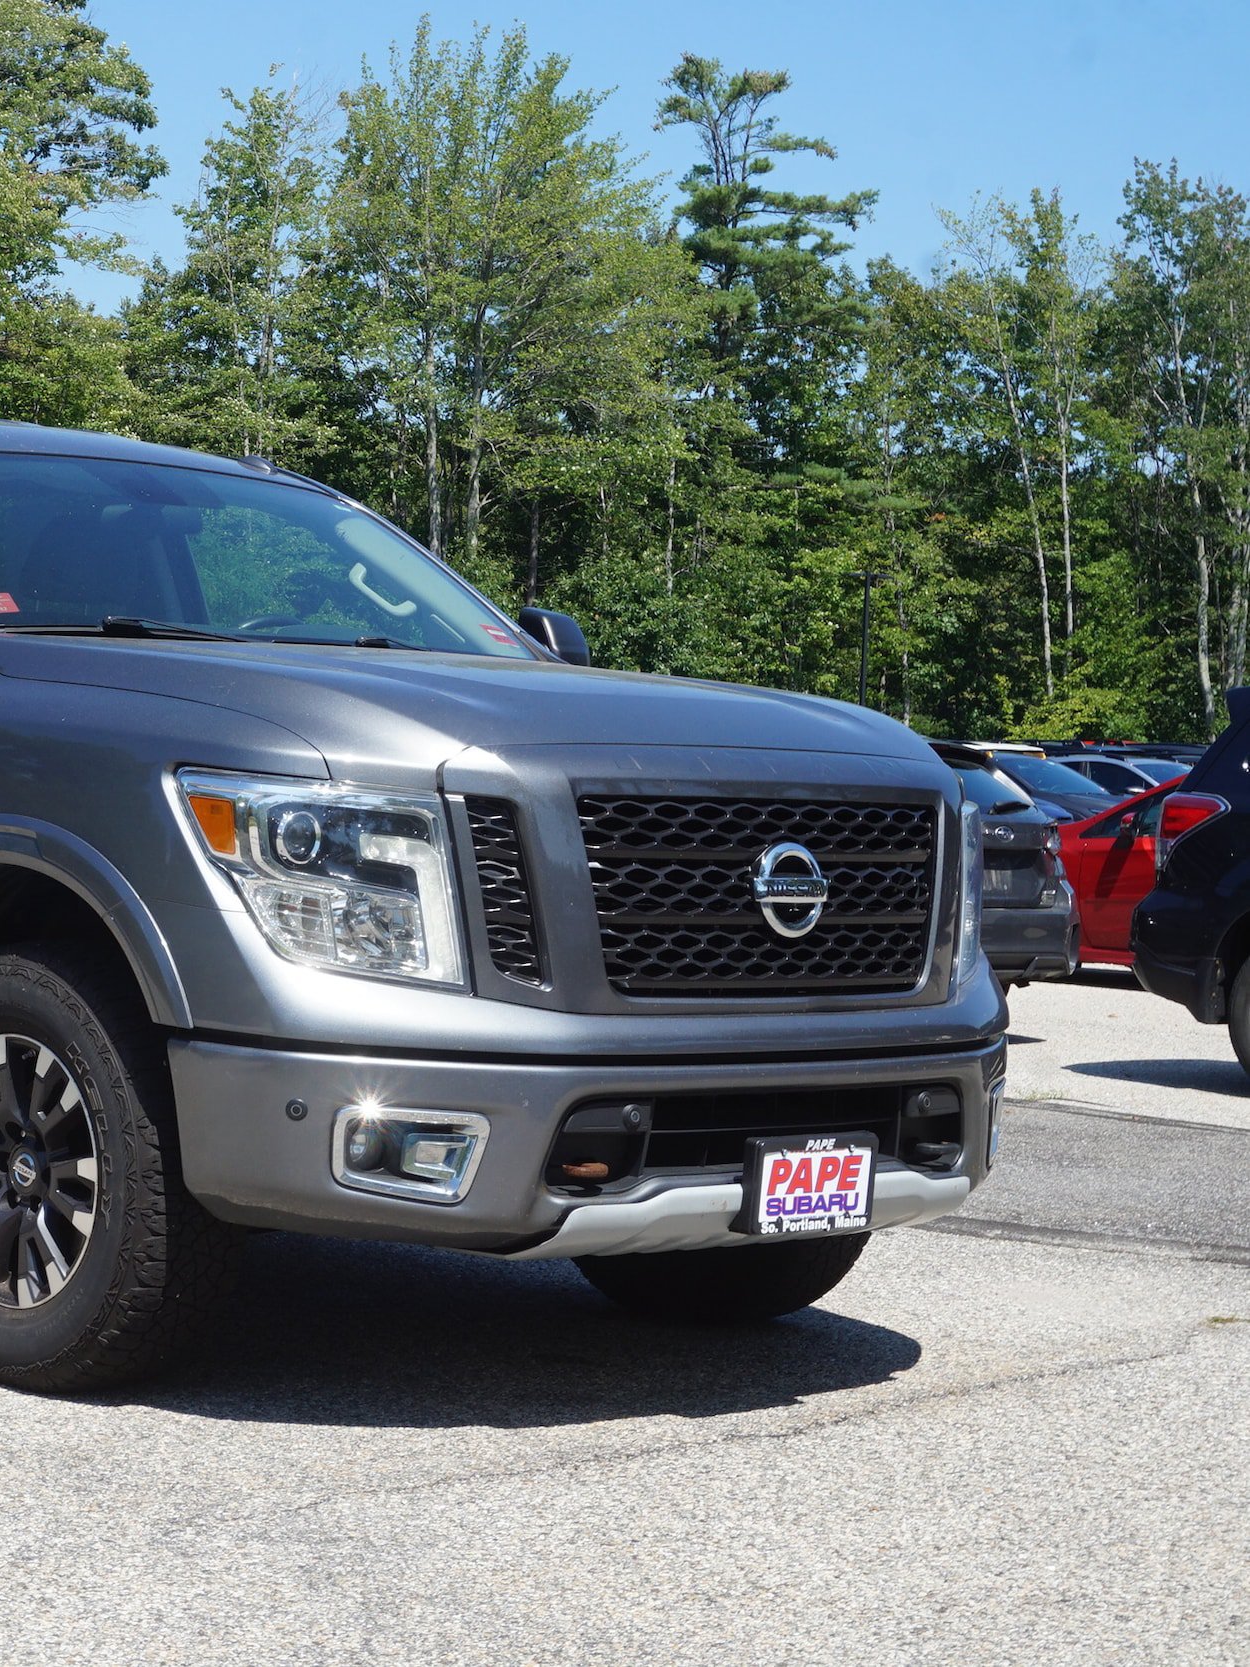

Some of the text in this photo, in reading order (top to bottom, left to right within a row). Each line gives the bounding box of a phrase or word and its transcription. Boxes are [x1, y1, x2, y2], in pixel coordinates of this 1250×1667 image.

[66, 1041, 112, 1230] KELLY
[805, 1138, 837, 1152] PAPE
[766, 1155, 863, 1196] PAPE
[766, 1192, 859, 1216] SUBARU
[761, 1221, 778, 1234] So.
[782, 1217, 831, 1231] Portland,
[835, 1216, 867, 1228] Maine
